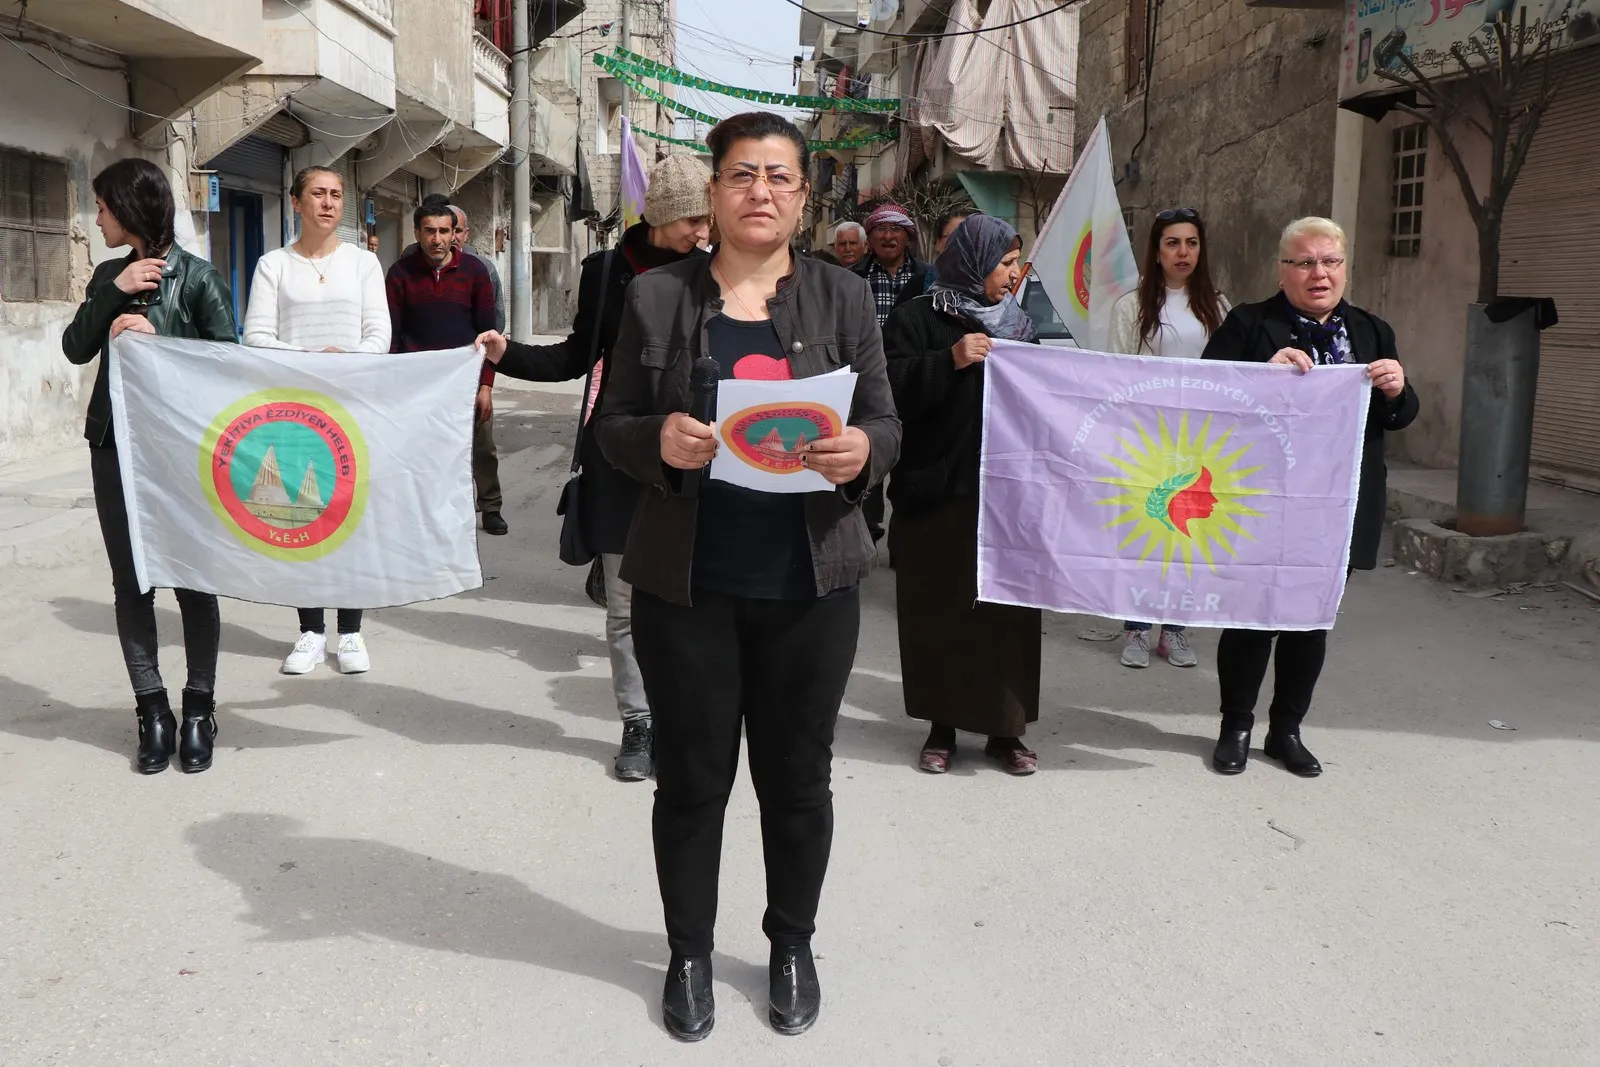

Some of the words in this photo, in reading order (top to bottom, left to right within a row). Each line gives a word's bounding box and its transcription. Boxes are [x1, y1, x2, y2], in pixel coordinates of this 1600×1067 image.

[327, 427, 350, 477] HELEB
[1127, 376, 1175, 397] JINÊN
[1254, 404, 1297, 471] ROJAVA
